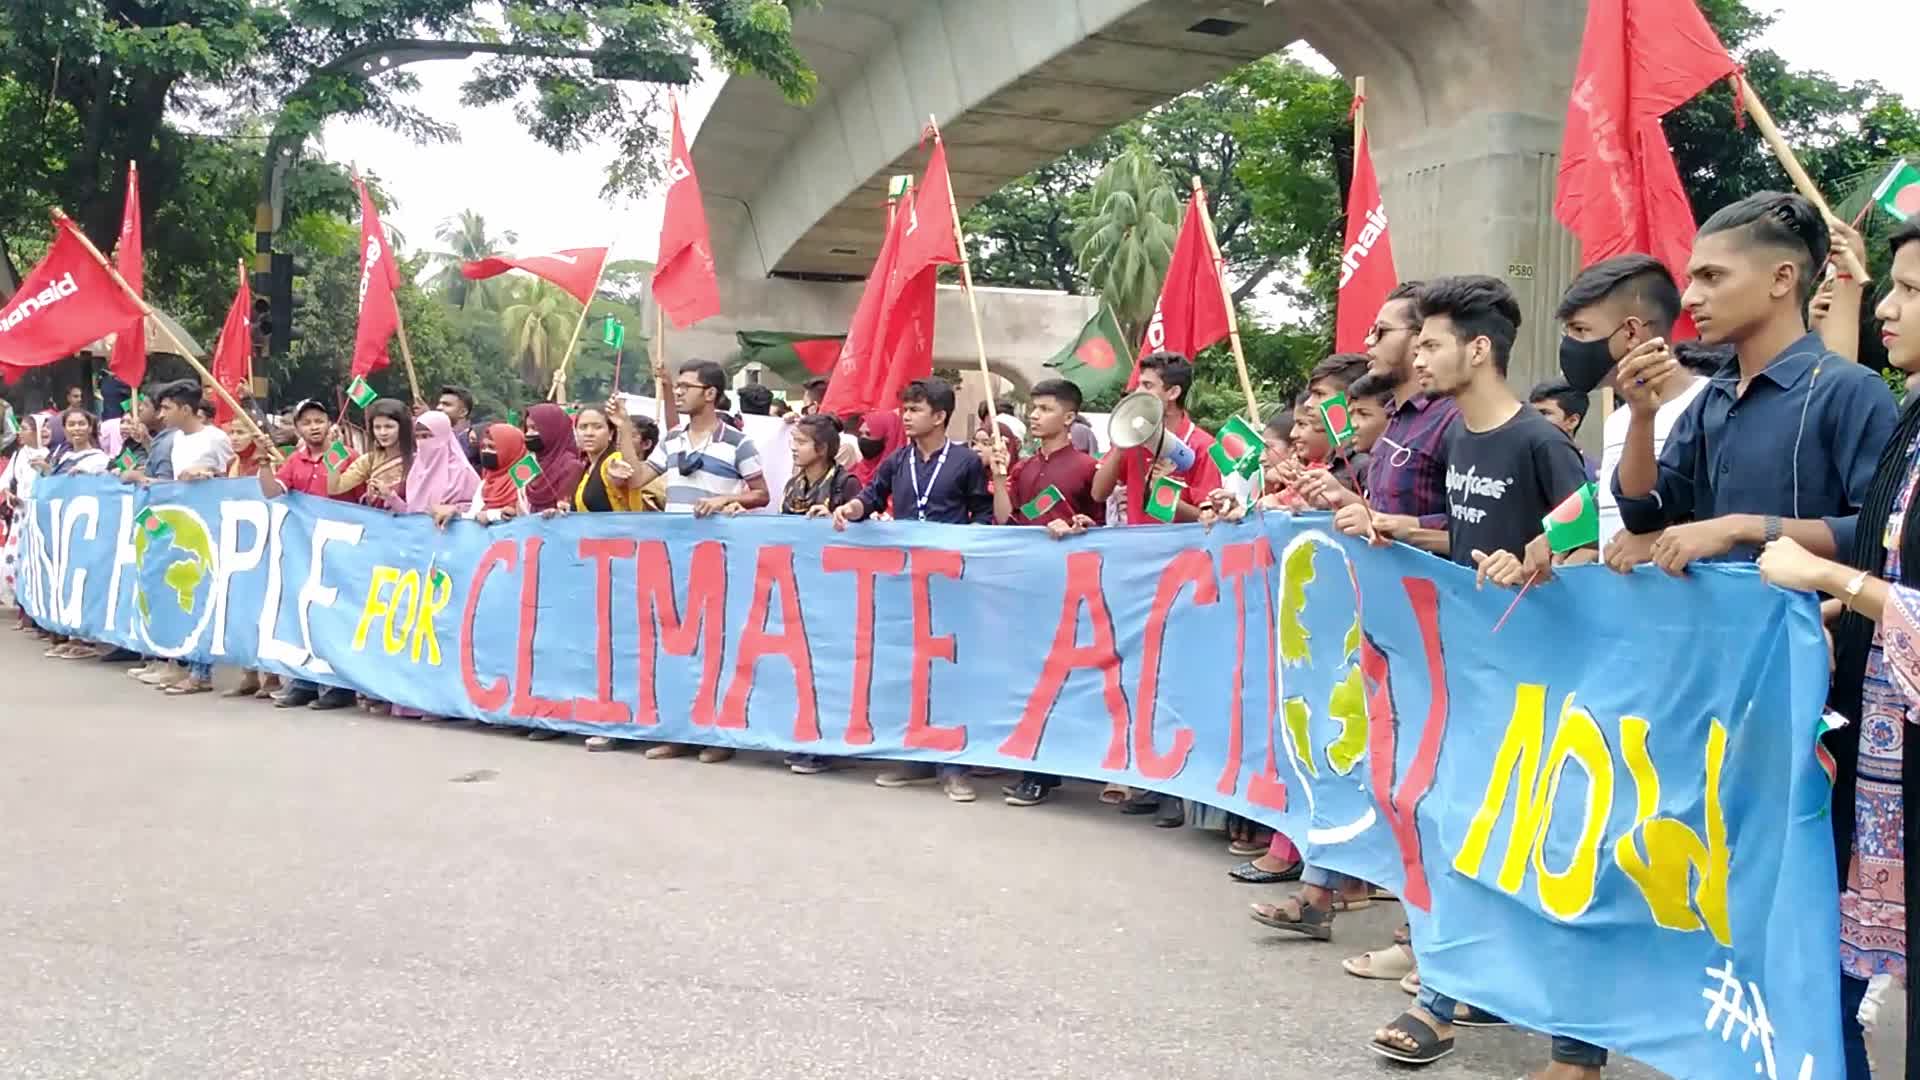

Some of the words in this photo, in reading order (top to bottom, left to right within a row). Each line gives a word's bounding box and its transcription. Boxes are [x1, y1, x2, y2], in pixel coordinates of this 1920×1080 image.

[352, 563, 453, 666] FOR
[460, 536, 967, 752] CLIMATE
[1452, 683, 1733, 948] NOW
